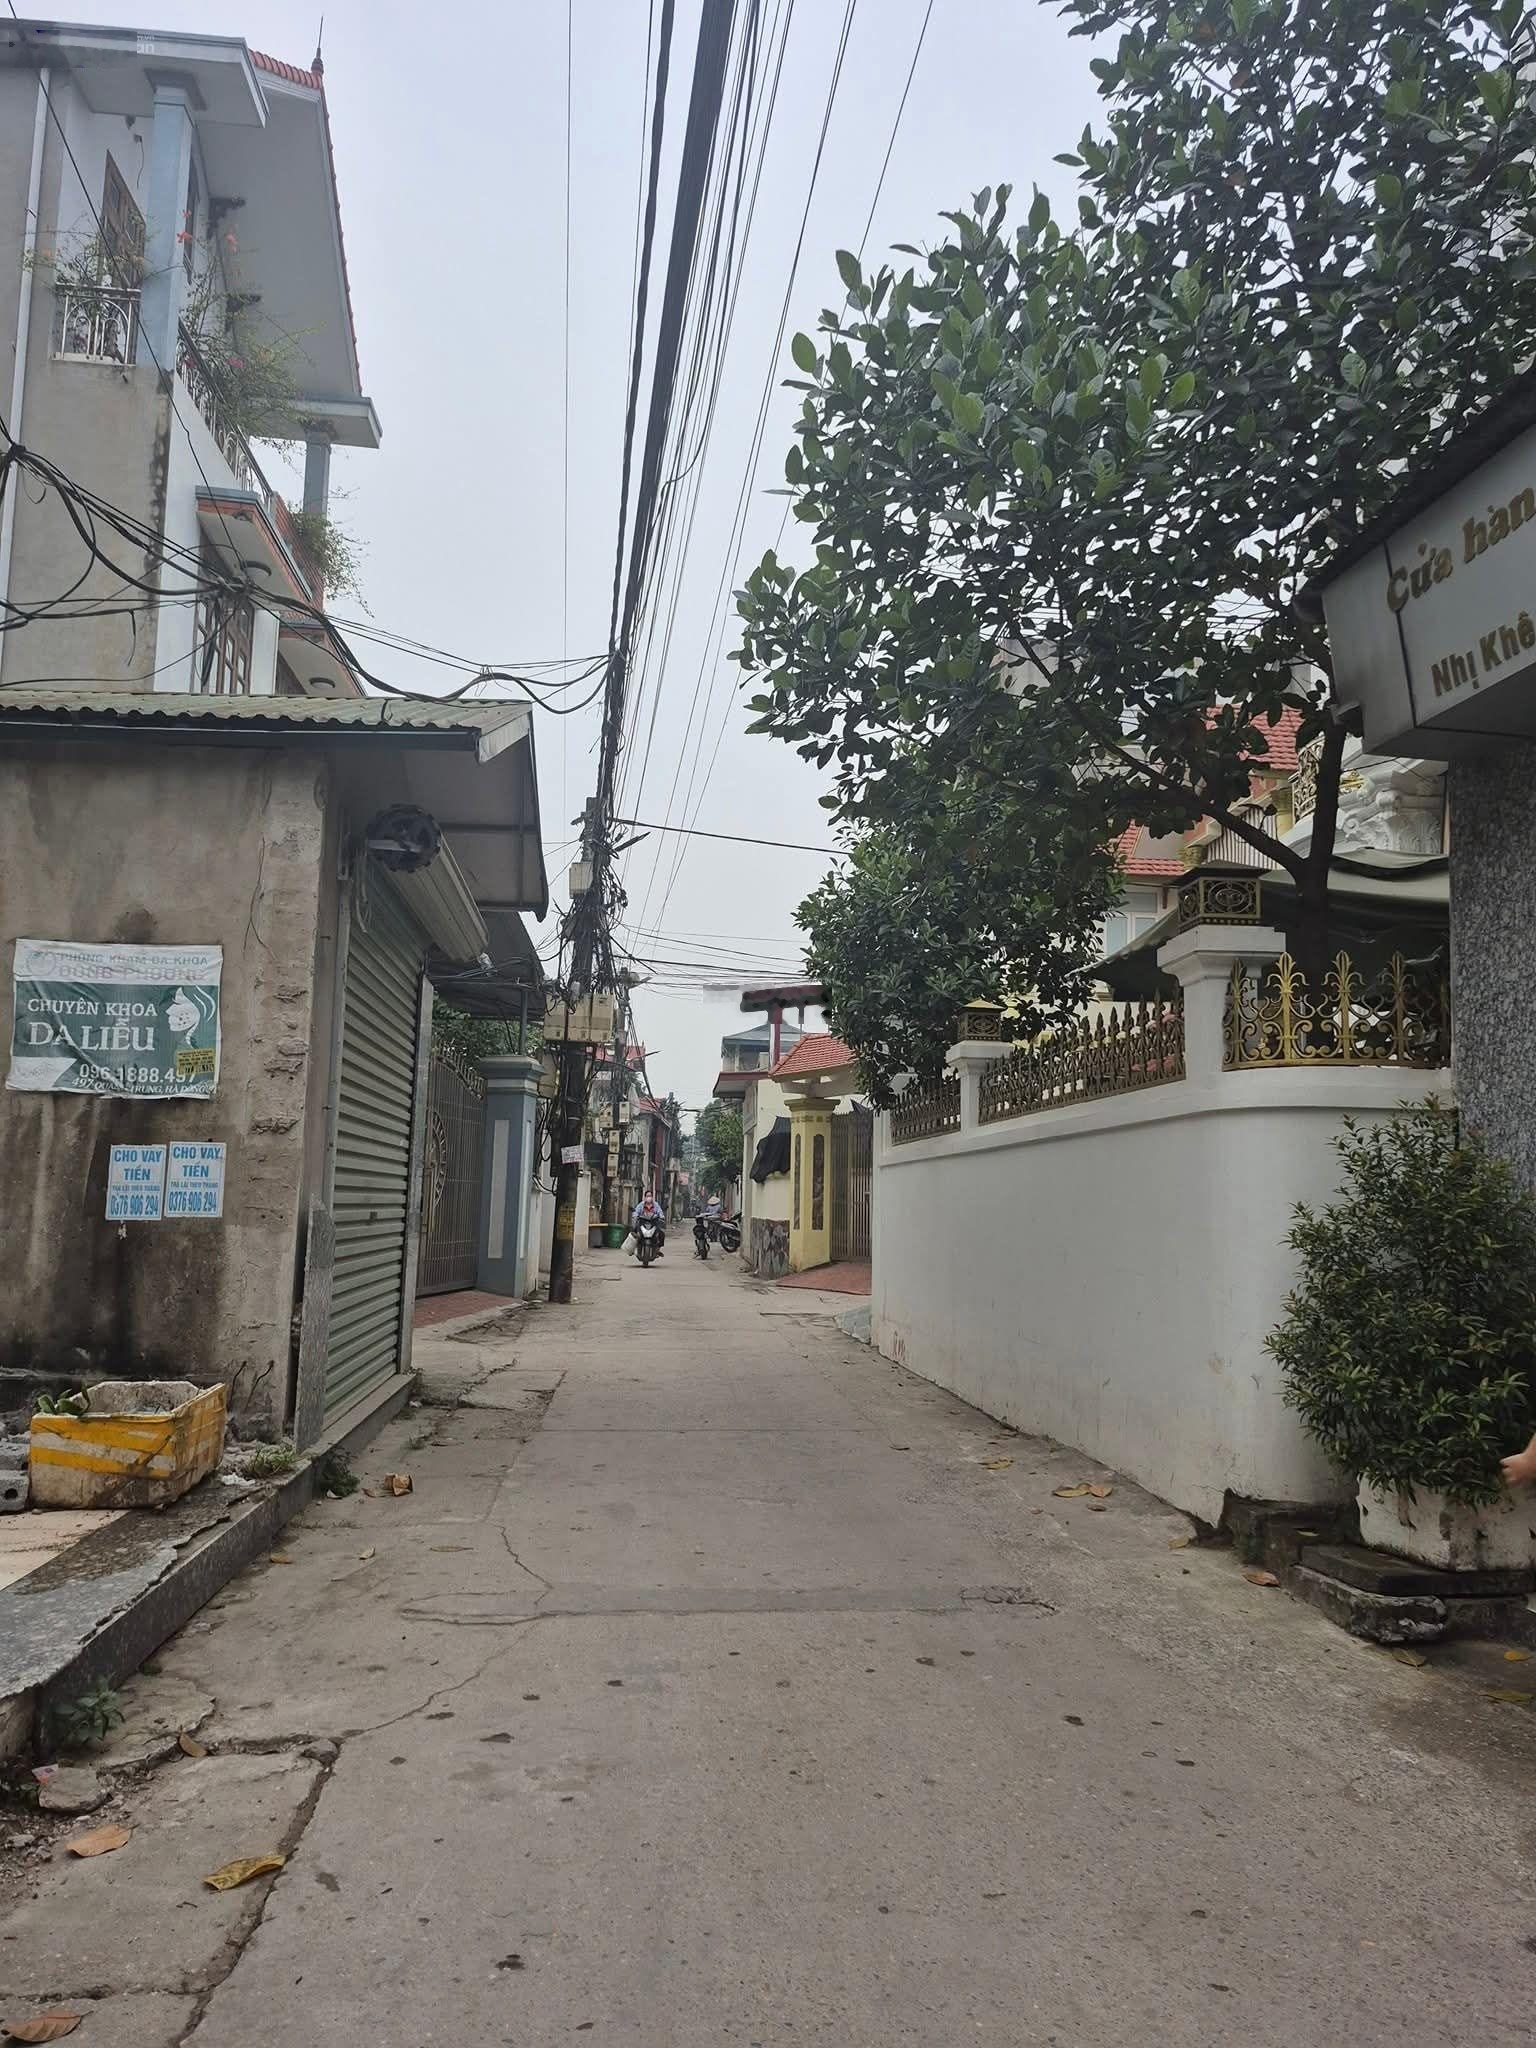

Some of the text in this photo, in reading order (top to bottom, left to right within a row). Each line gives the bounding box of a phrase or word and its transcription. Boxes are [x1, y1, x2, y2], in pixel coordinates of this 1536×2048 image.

[1387, 542, 1454, 613] Cửa
[1430, 610, 1536, 698] Nhị Khê
[27, 996, 158, 1017] CHUYÊN KHOA
[28, 1017, 156, 1052] DA LIỄU
[114, 1149, 162, 1163] CHO VAY
[173, 1146, 221, 1160] CHO VAY
[145, 1194, 159, 1216] 294
[168, 1191, 187, 1212] 0376
[203, 1191, 217, 1212] 294
